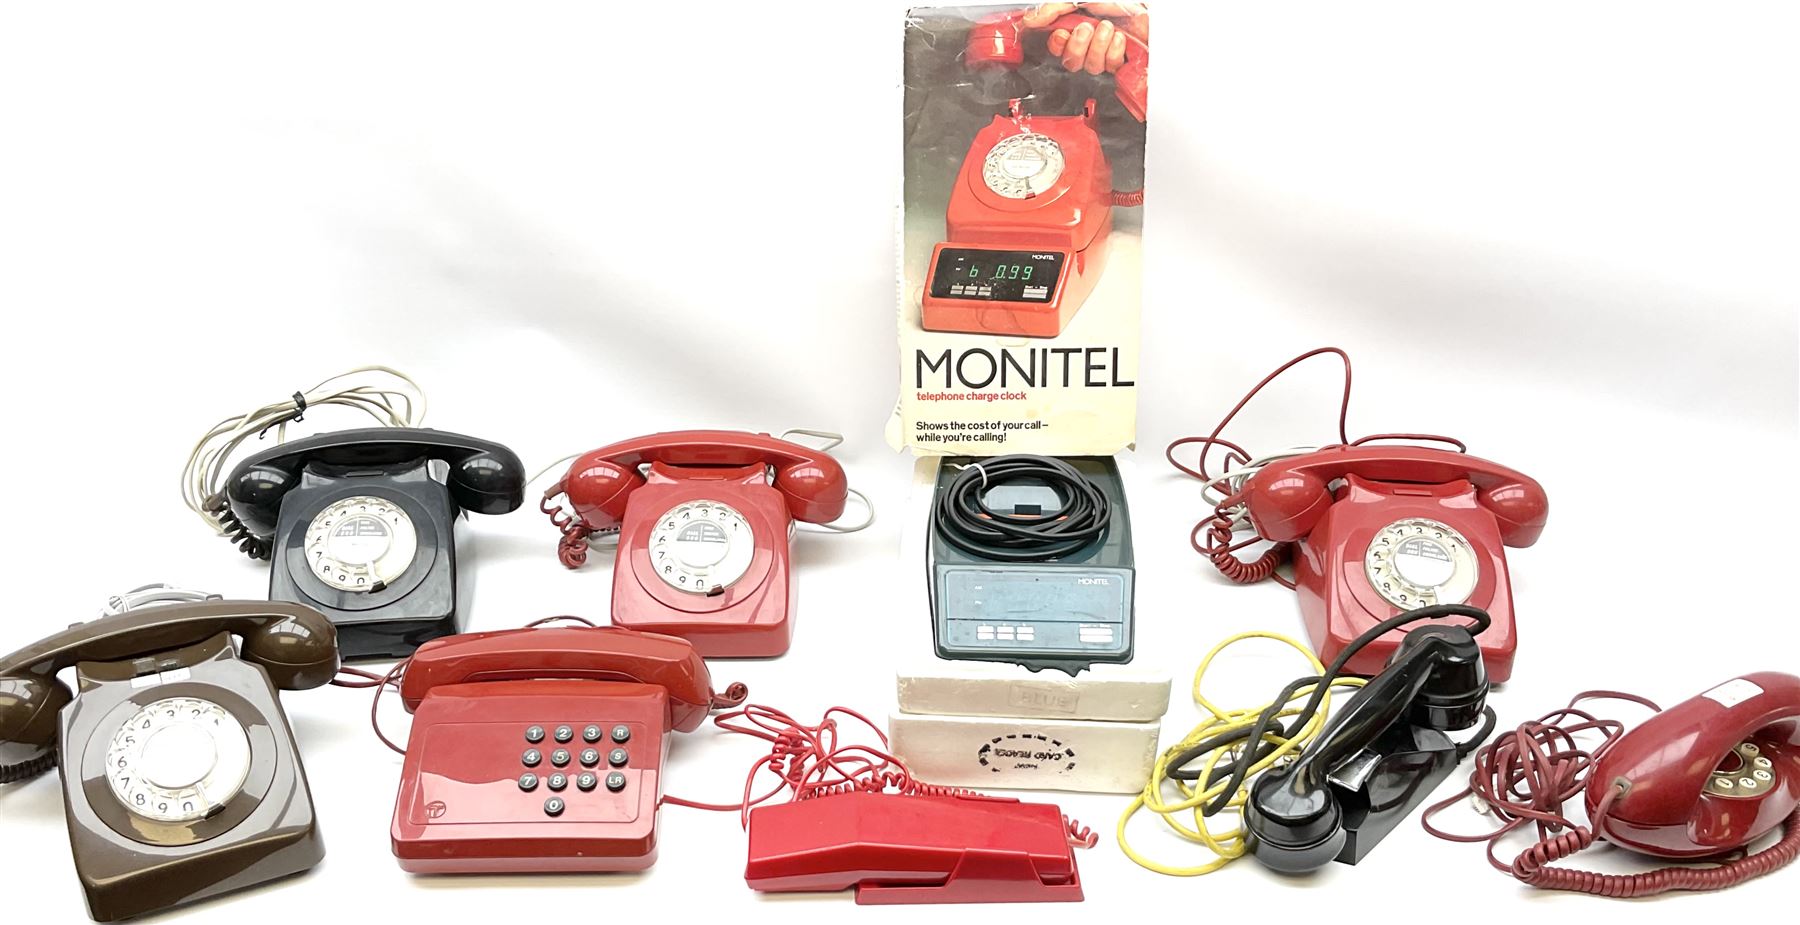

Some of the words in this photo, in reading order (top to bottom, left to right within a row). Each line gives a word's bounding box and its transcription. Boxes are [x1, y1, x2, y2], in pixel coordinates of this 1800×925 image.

[916, 348, 1135, 389] MONITEL
[917, 392, 965, 402] telephone
[966, 392, 999, 402] charge
[1001, 392, 1027, 400] clock
[916, 422, 948, 430] Shows
[950, 422, 966, 430] the
[968, 422, 989, 430] cost
[991, 421, 1001, 430] of
[1003, 422, 1024, 431] your
[917, 433, 941, 442] while
[943, 433, 972, 443] you're
[974, 433, 1006, 443] calling!
[659, 551, 666, 559] 7
[532, 729, 537, 738] 1
[560, 729, 568, 737] 2
[588, 728, 596, 737] 3
[527, 752, 536, 761] 4
[556, 752, 564, 761] 5
[585, 752, 593, 760] 6
[117, 756, 128, 768] 6
[121, 776, 130, 790] 7
[524, 776, 532, 785] 7
[553, 776, 561, 784] 8
[582, 776, 590, 784] 9
[608, 776, 622, 784] LR
[136, 793, 146, 806] 8
[158, 802, 168, 814] 9
[549, 801, 559, 810] 0
